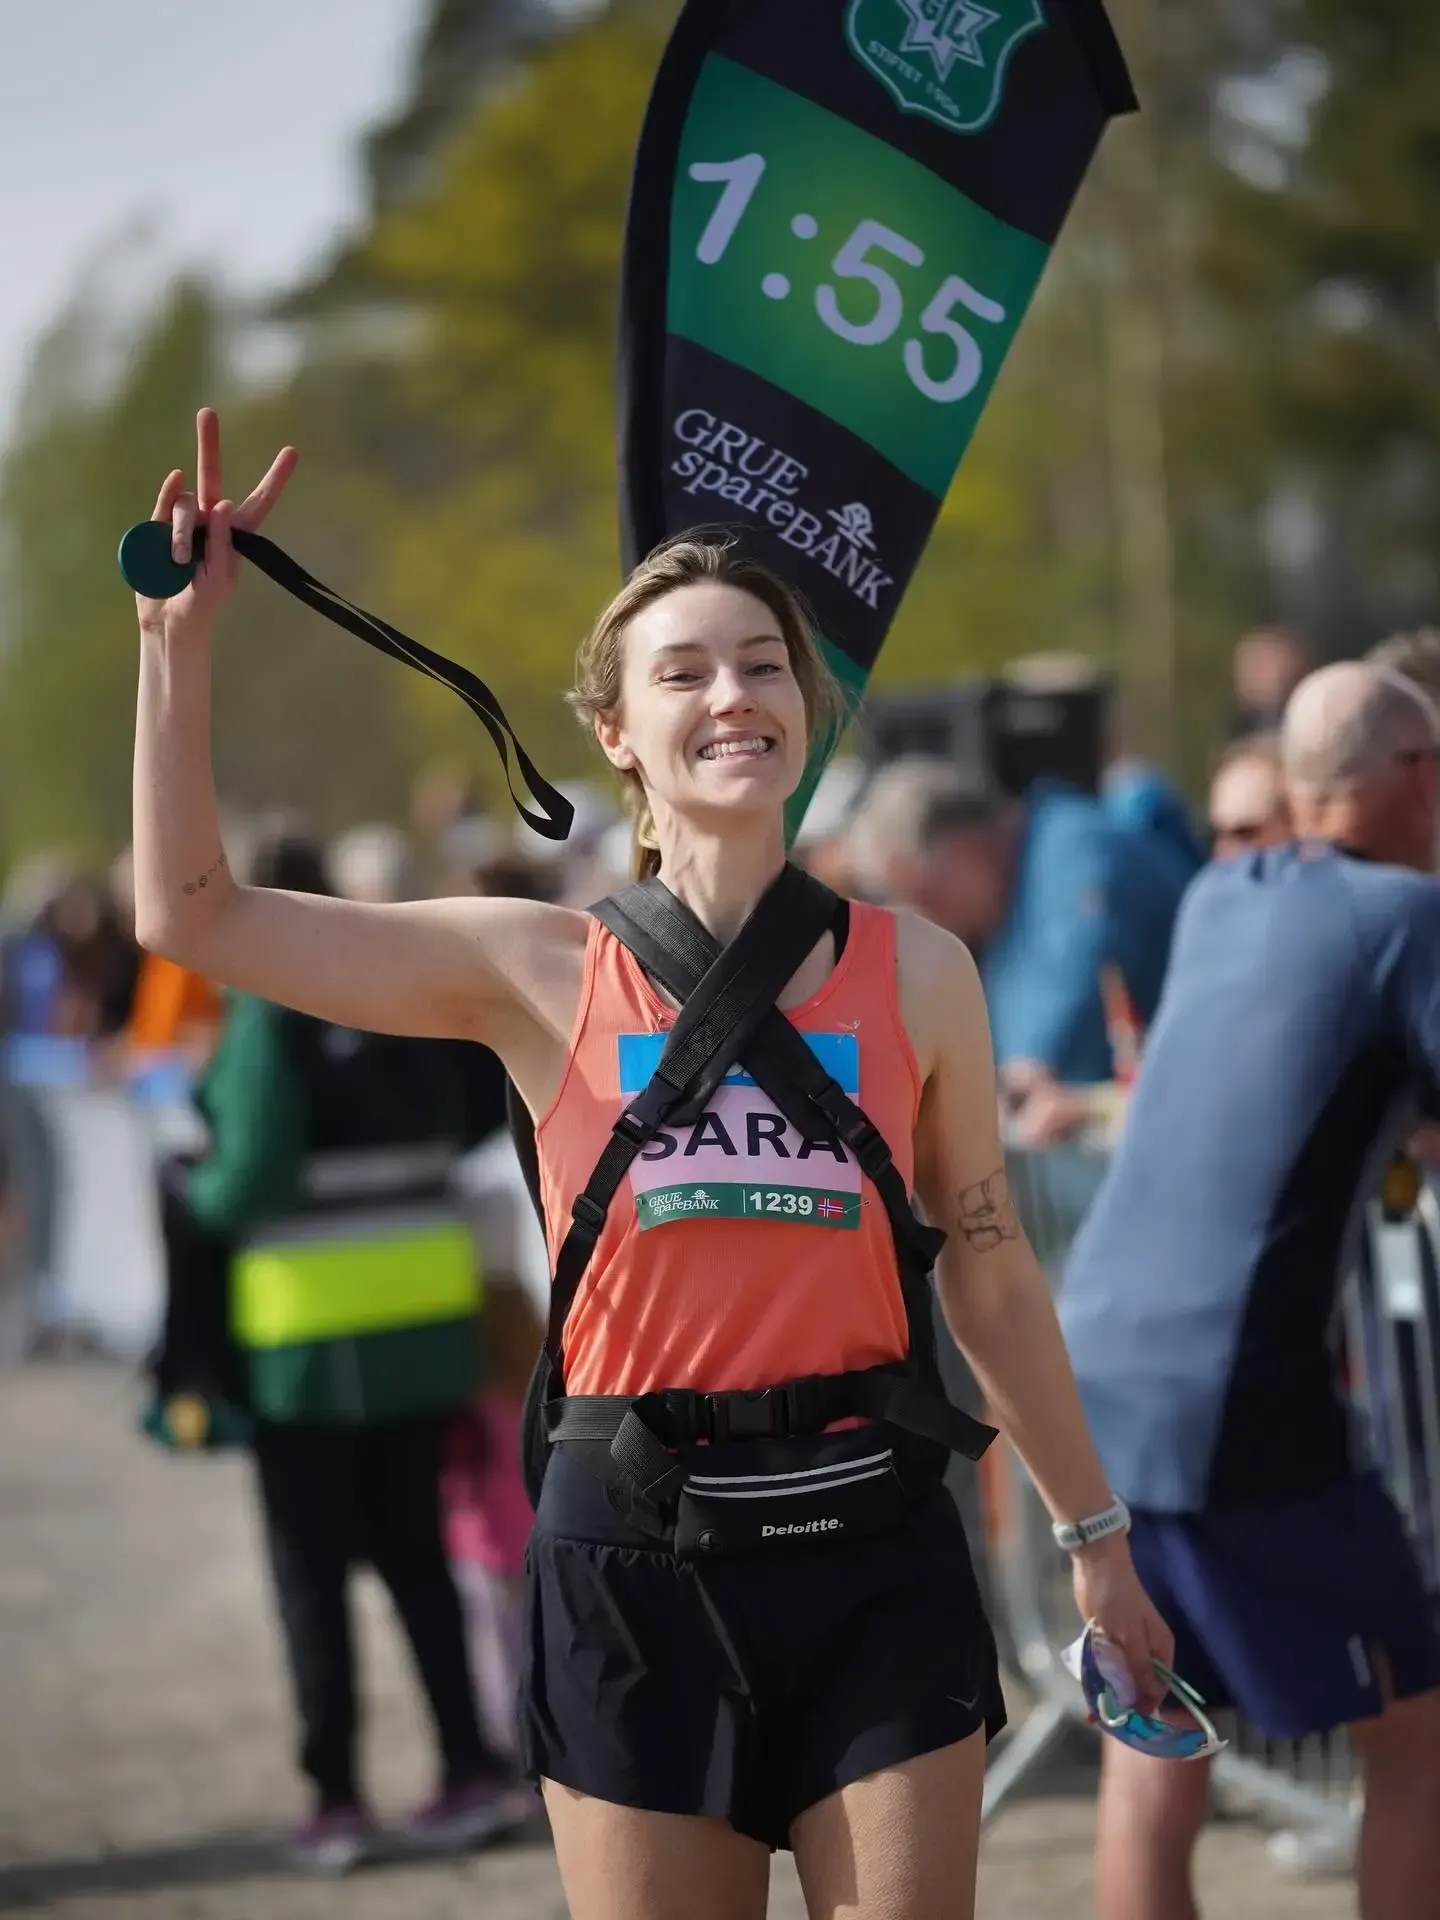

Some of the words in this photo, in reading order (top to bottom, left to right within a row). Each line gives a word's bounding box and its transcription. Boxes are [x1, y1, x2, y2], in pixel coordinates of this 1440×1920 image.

[688, 153, 1006, 403] 1:55
[673, 408, 809, 495] GRUE
[671, 450, 894, 610] spareBANK
[648, 1191, 682, 1208] GRUE
[653, 1199, 720, 1217] spareBANK
[750, 1191, 813, 1216] 1239
